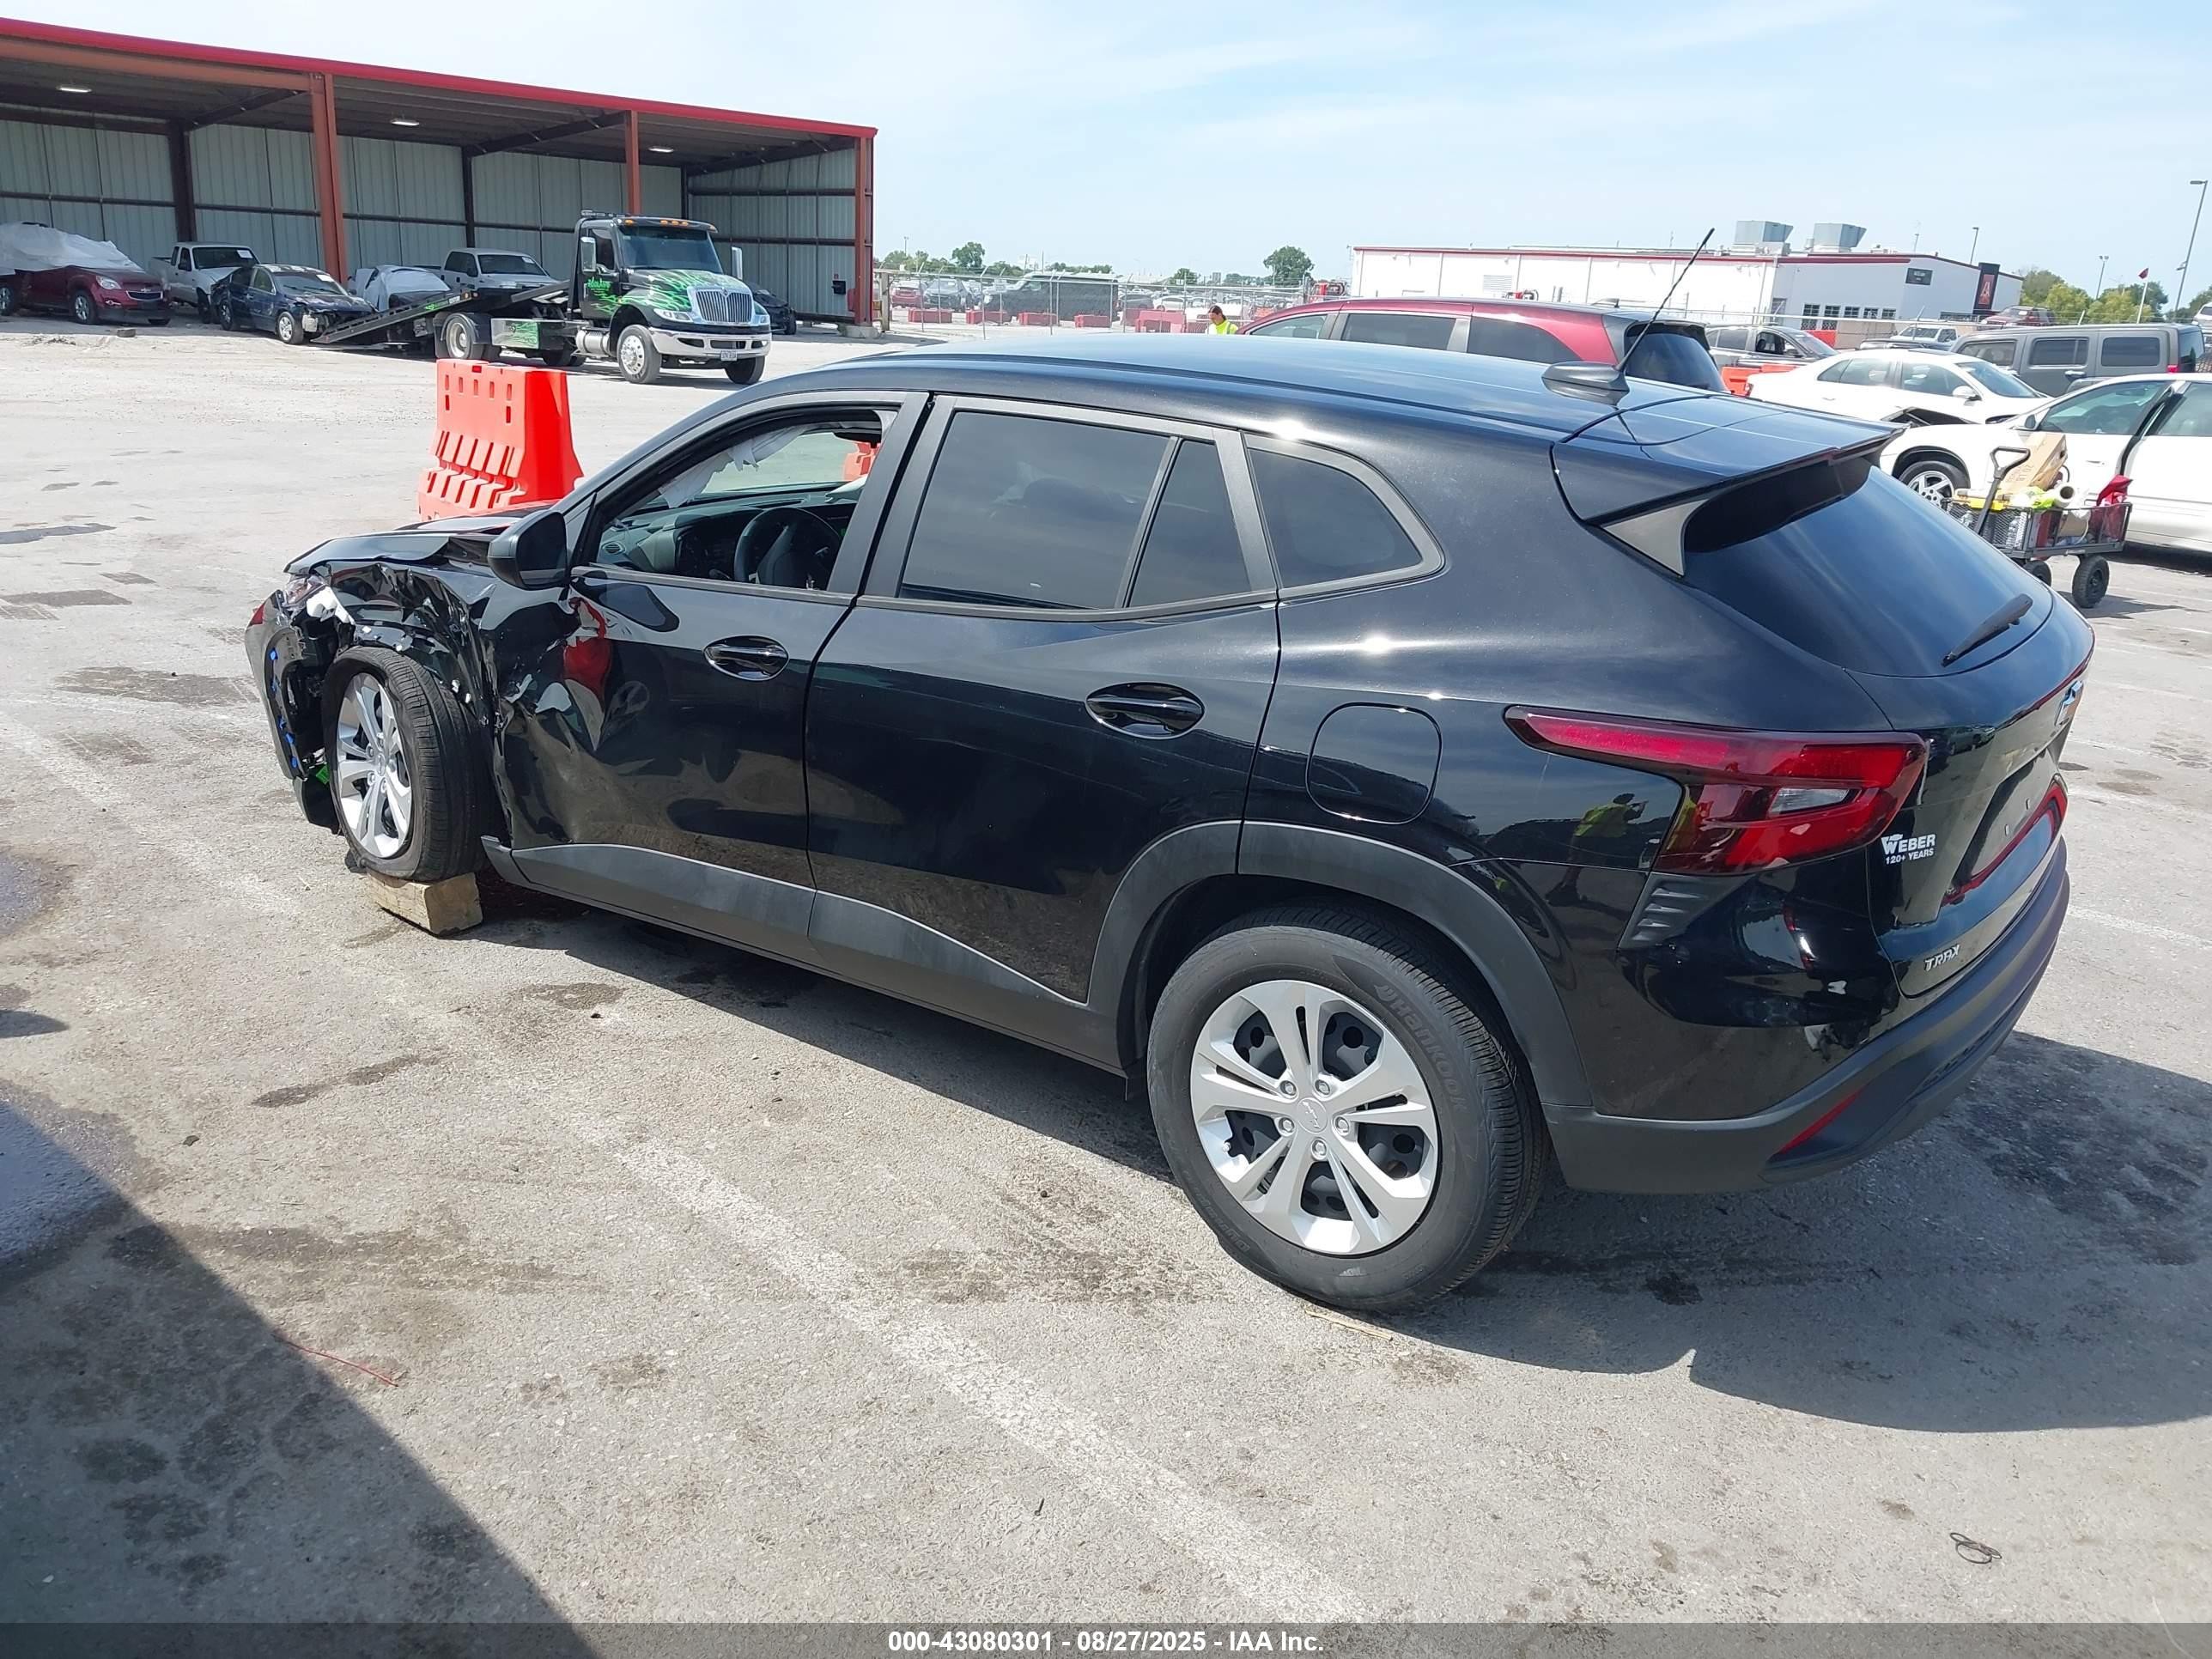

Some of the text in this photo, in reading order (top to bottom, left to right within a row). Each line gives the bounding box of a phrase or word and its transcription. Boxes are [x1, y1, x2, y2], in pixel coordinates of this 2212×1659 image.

[1881, 834, 1936, 855] WEBER
[1886, 848, 1934, 865] 120+ YEARS
[1924, 945, 1960, 971] TRAX
